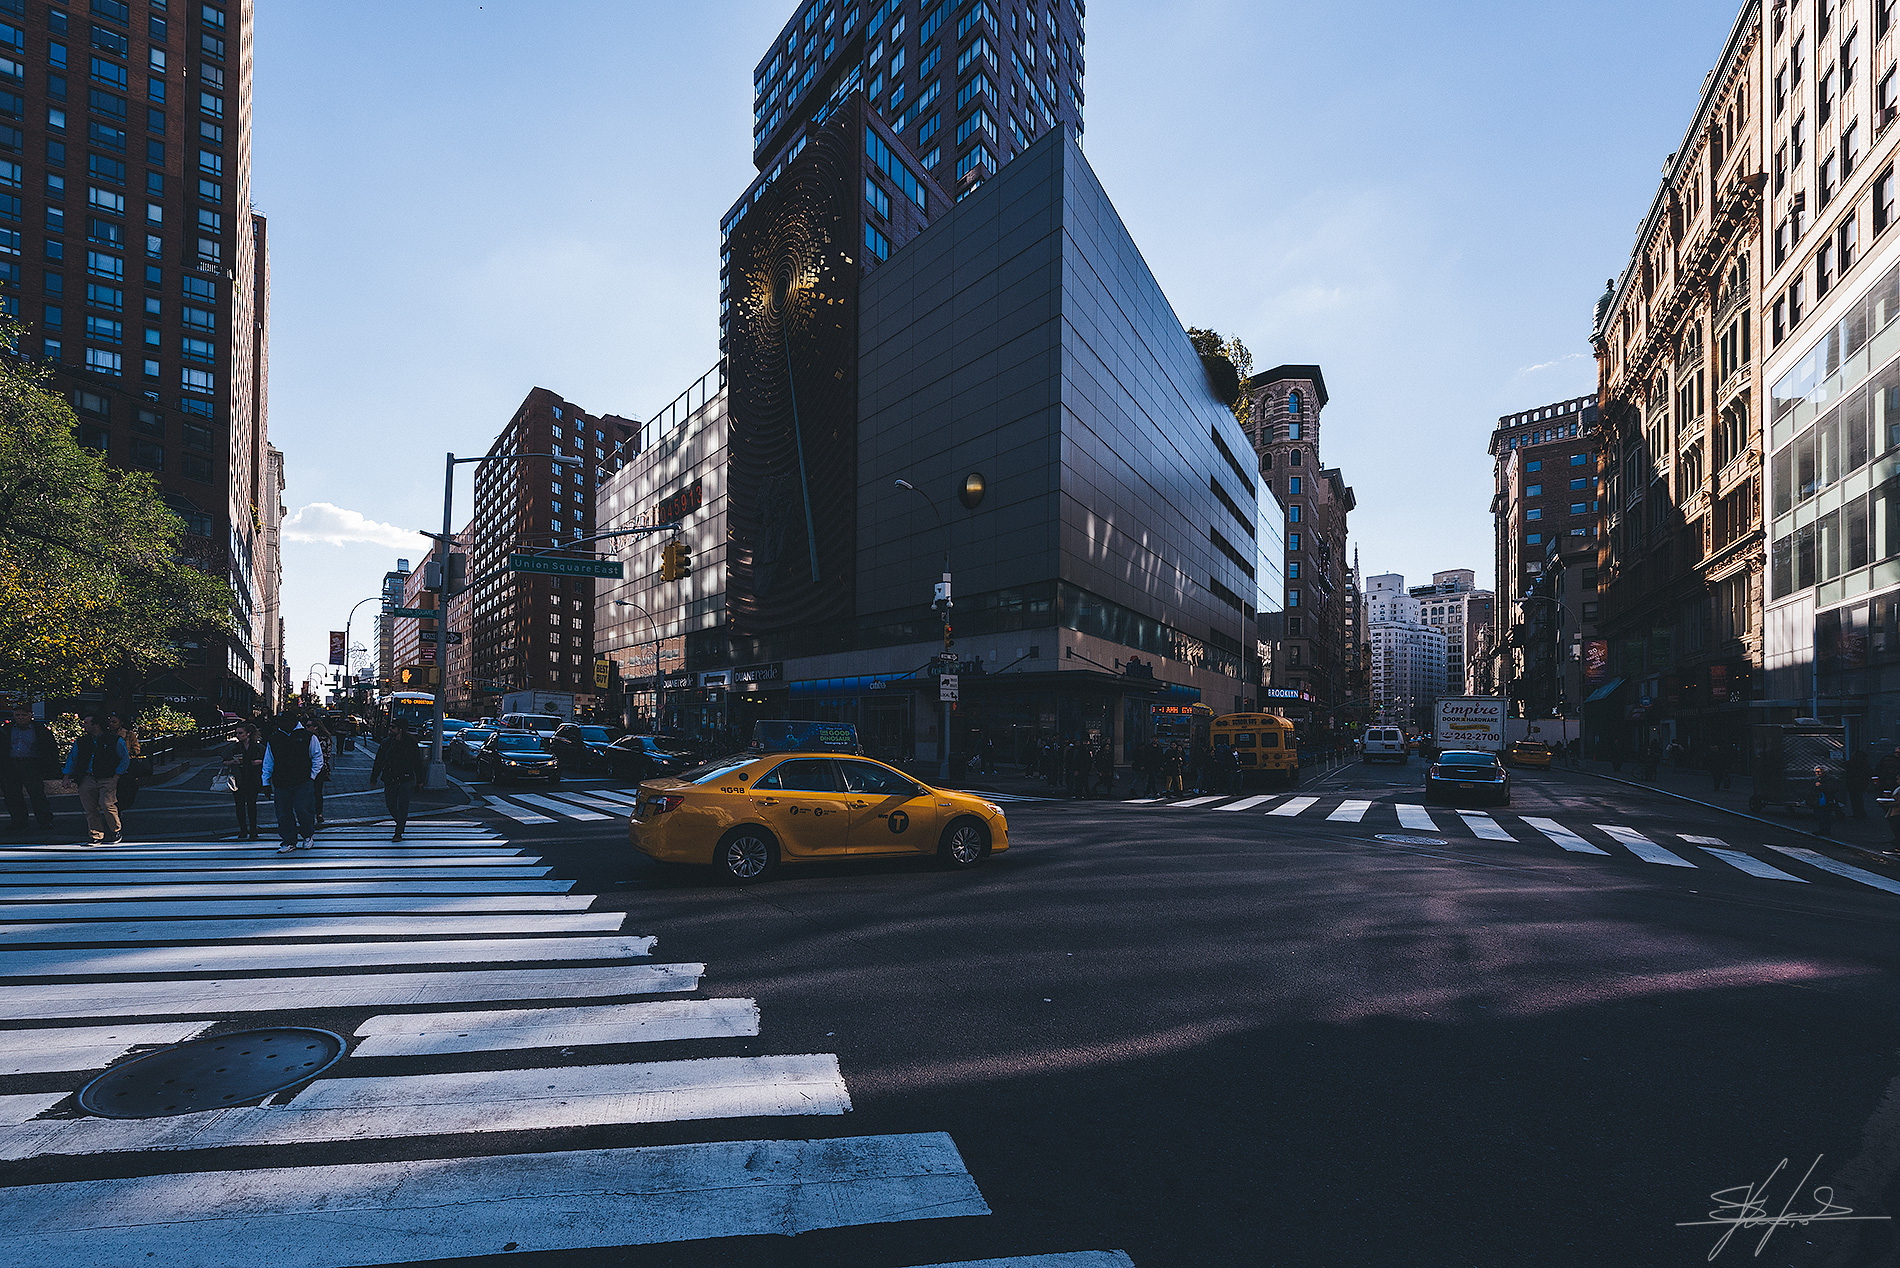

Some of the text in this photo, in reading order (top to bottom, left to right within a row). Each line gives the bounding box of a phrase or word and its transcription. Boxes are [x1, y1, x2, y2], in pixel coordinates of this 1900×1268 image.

[514, 559, 619, 575] Union Square East
[596, 664, 608, 673] BEST
[596, 674, 607, 683] BUY
[1267, 688, 1299, 698] BROOKLYN
[1442, 702, 1499, 718] Empire
[1454, 732, 1500, 741] 242-2700
